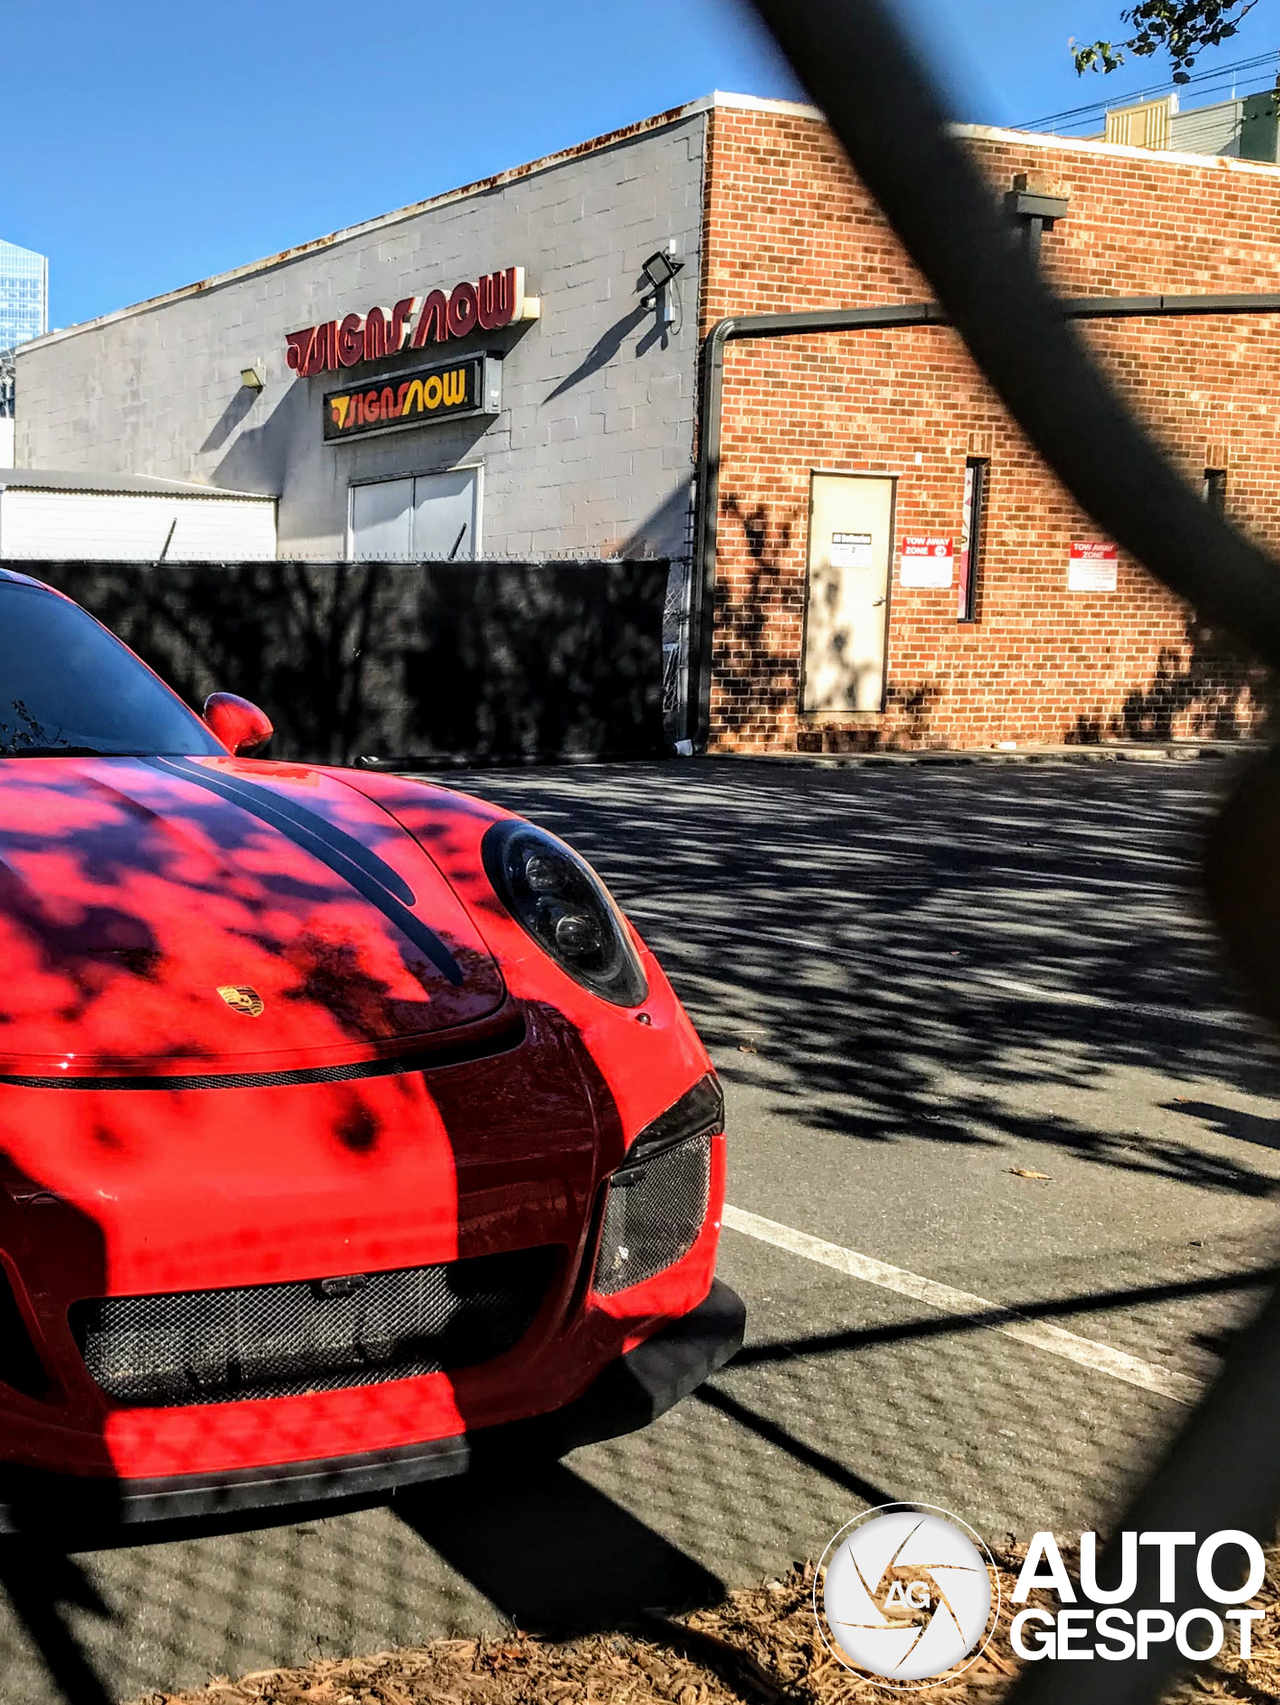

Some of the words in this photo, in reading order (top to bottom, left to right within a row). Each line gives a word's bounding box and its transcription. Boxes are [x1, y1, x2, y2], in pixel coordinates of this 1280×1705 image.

[906, 537, 926, 545] TOW
[926, 538, 950, 546] AWAY
[905, 546, 928, 554] ZONE
[1073, 543, 1092, 551] TOW
